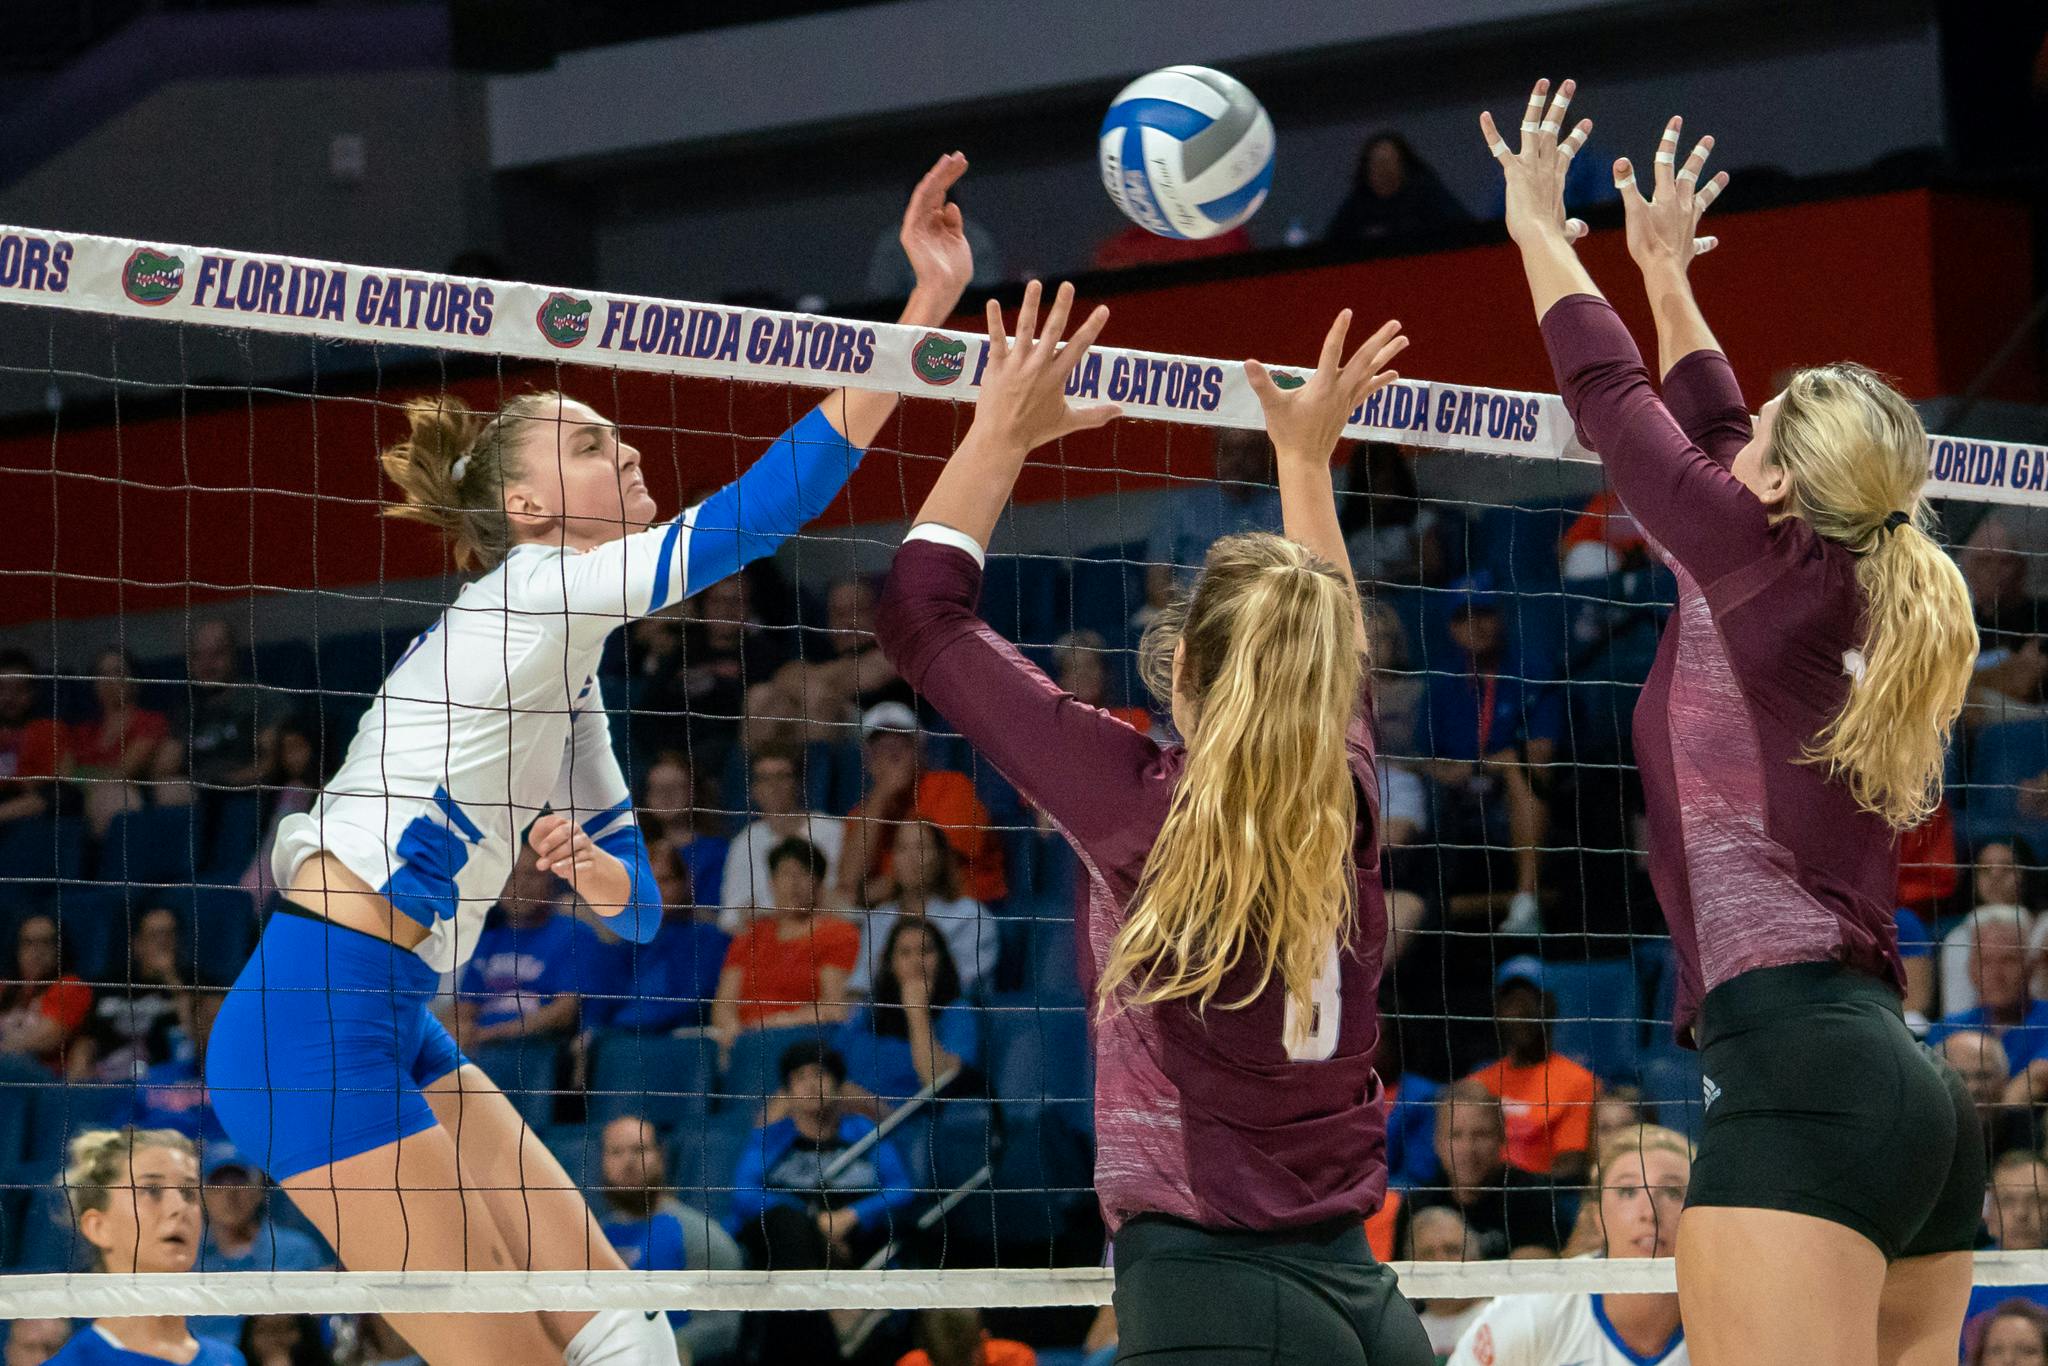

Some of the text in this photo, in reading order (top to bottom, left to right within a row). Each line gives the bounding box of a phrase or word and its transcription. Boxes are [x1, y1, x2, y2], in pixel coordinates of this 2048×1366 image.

[0, 234, 74, 293] ORS
[190, 255, 495, 337] FLORIDA GATORS
[596, 299, 877, 374] FLORIDA GATORS
[1106, 355, 1224, 412] GATORS
[1348, 383, 1541, 442] RIDA GATORS
[1927, 439, 2048, 492] ORIDA GA
